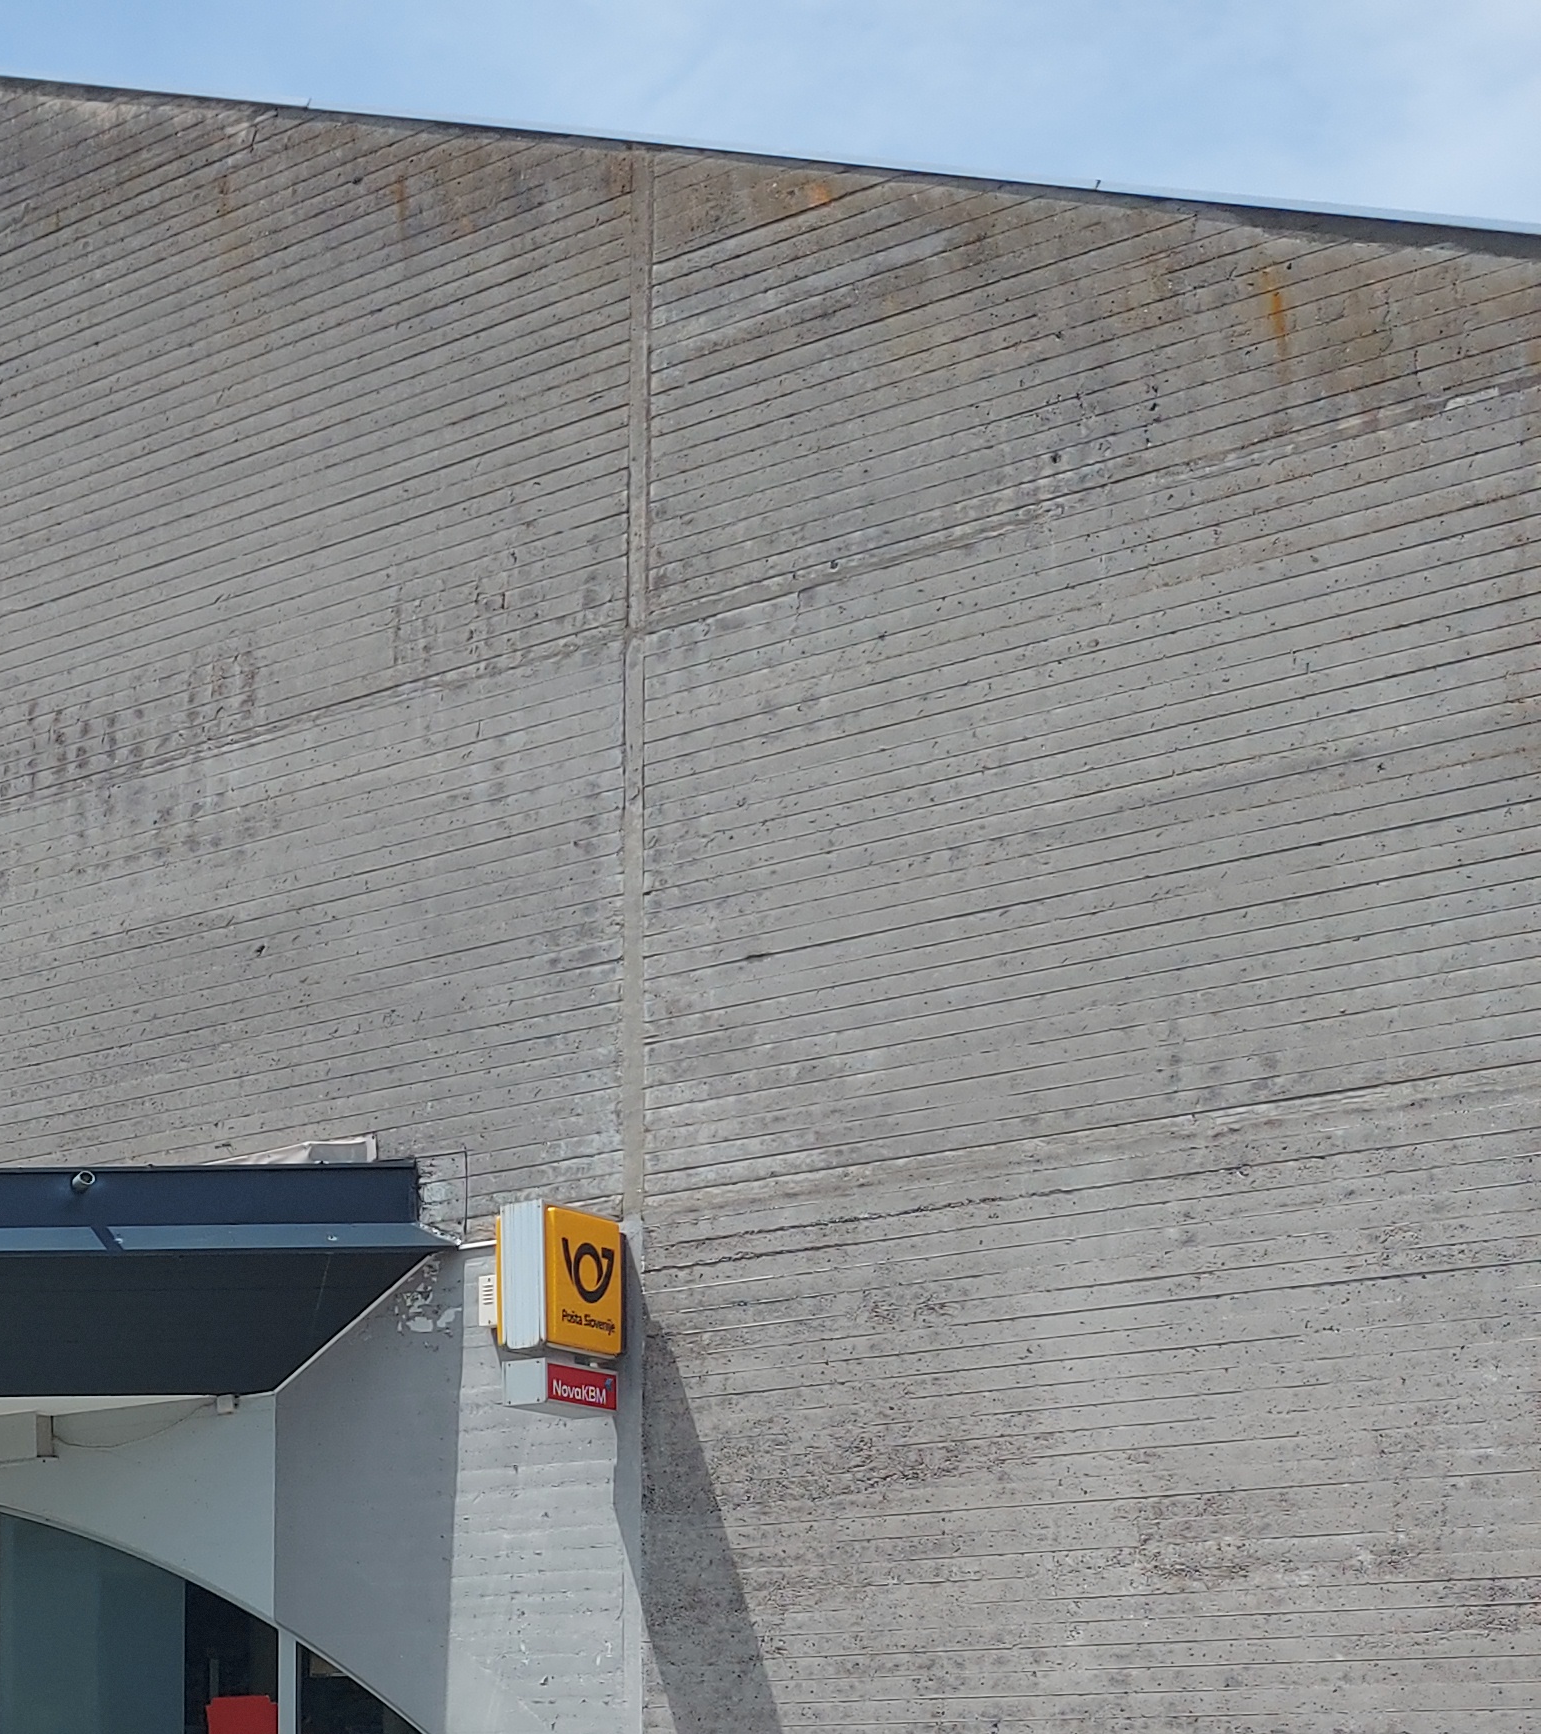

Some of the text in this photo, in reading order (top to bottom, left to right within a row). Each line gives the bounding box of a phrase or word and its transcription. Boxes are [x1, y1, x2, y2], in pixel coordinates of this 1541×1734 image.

[561, 1308, 615, 1336] Pošta Slovenije
[552, 1379, 607, 1405] NovaKBM
